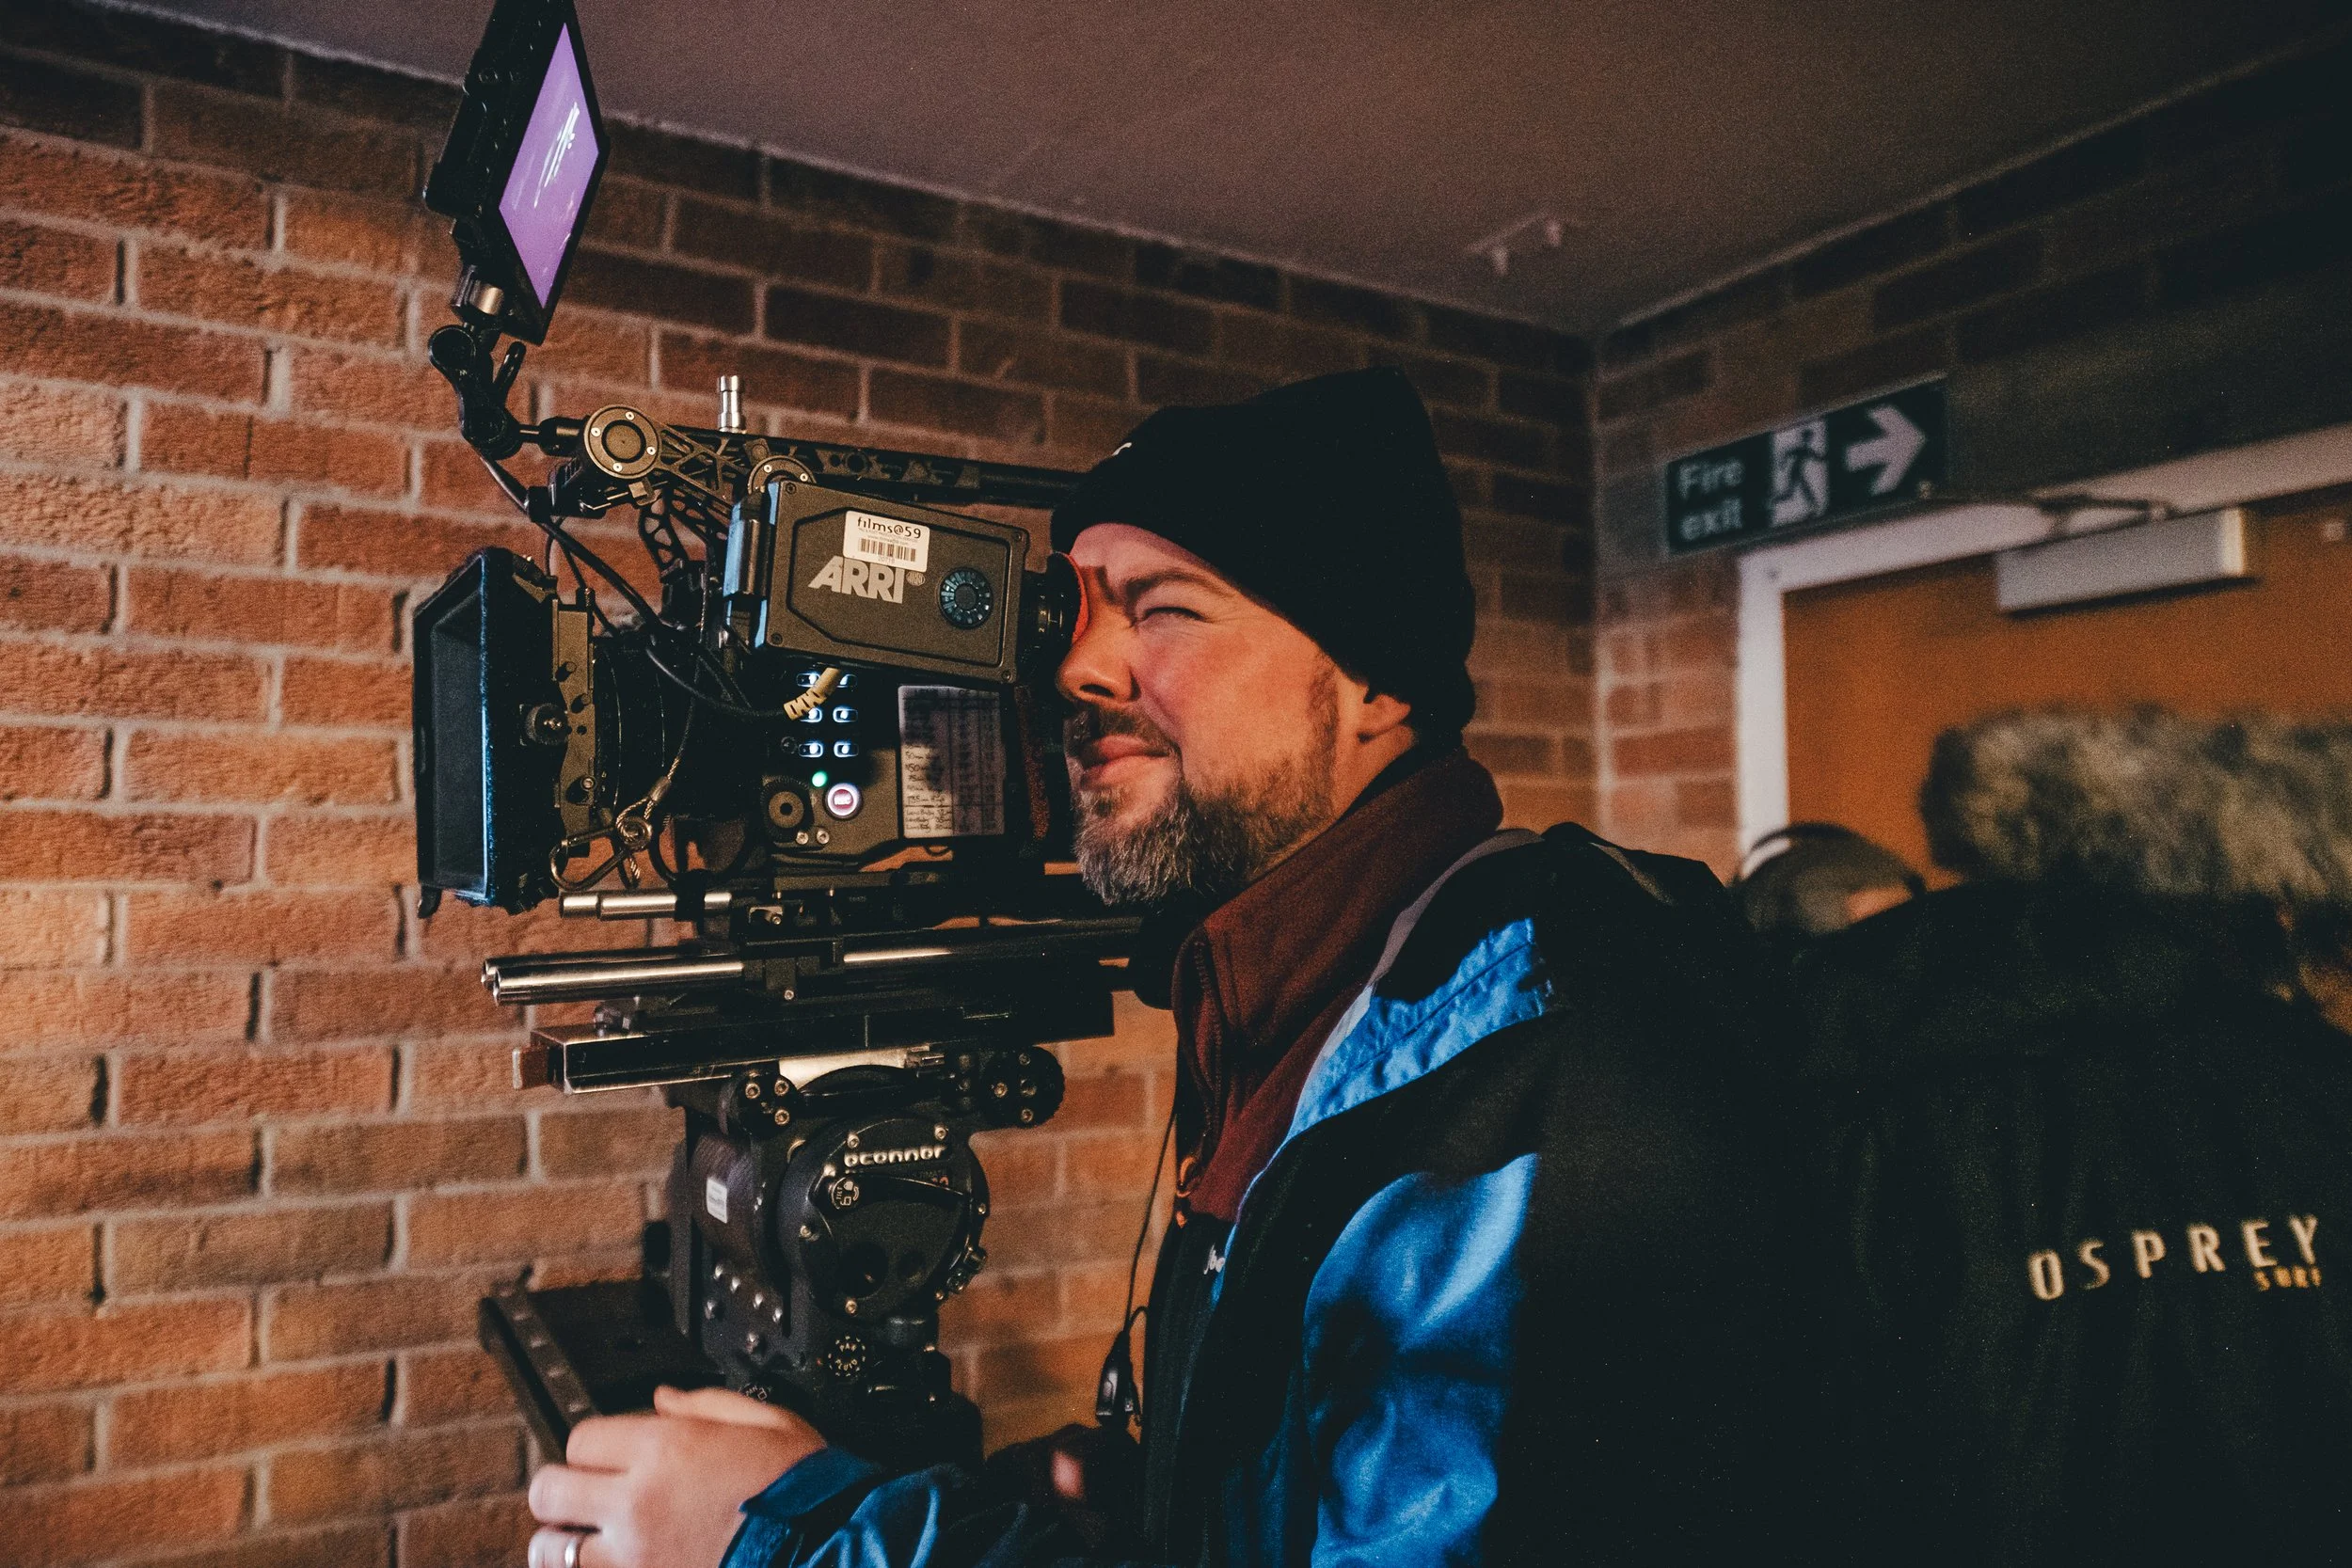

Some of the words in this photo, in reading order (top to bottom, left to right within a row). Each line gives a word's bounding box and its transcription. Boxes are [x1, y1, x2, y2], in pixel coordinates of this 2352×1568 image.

[1677, 460, 1743, 499] Fire
[858, 516, 921, 539] films@59
[1679, 498, 1743, 540] exit
[808, 555, 905, 604] ARRI
[2027, 1214, 2318, 1301] OSPREY
